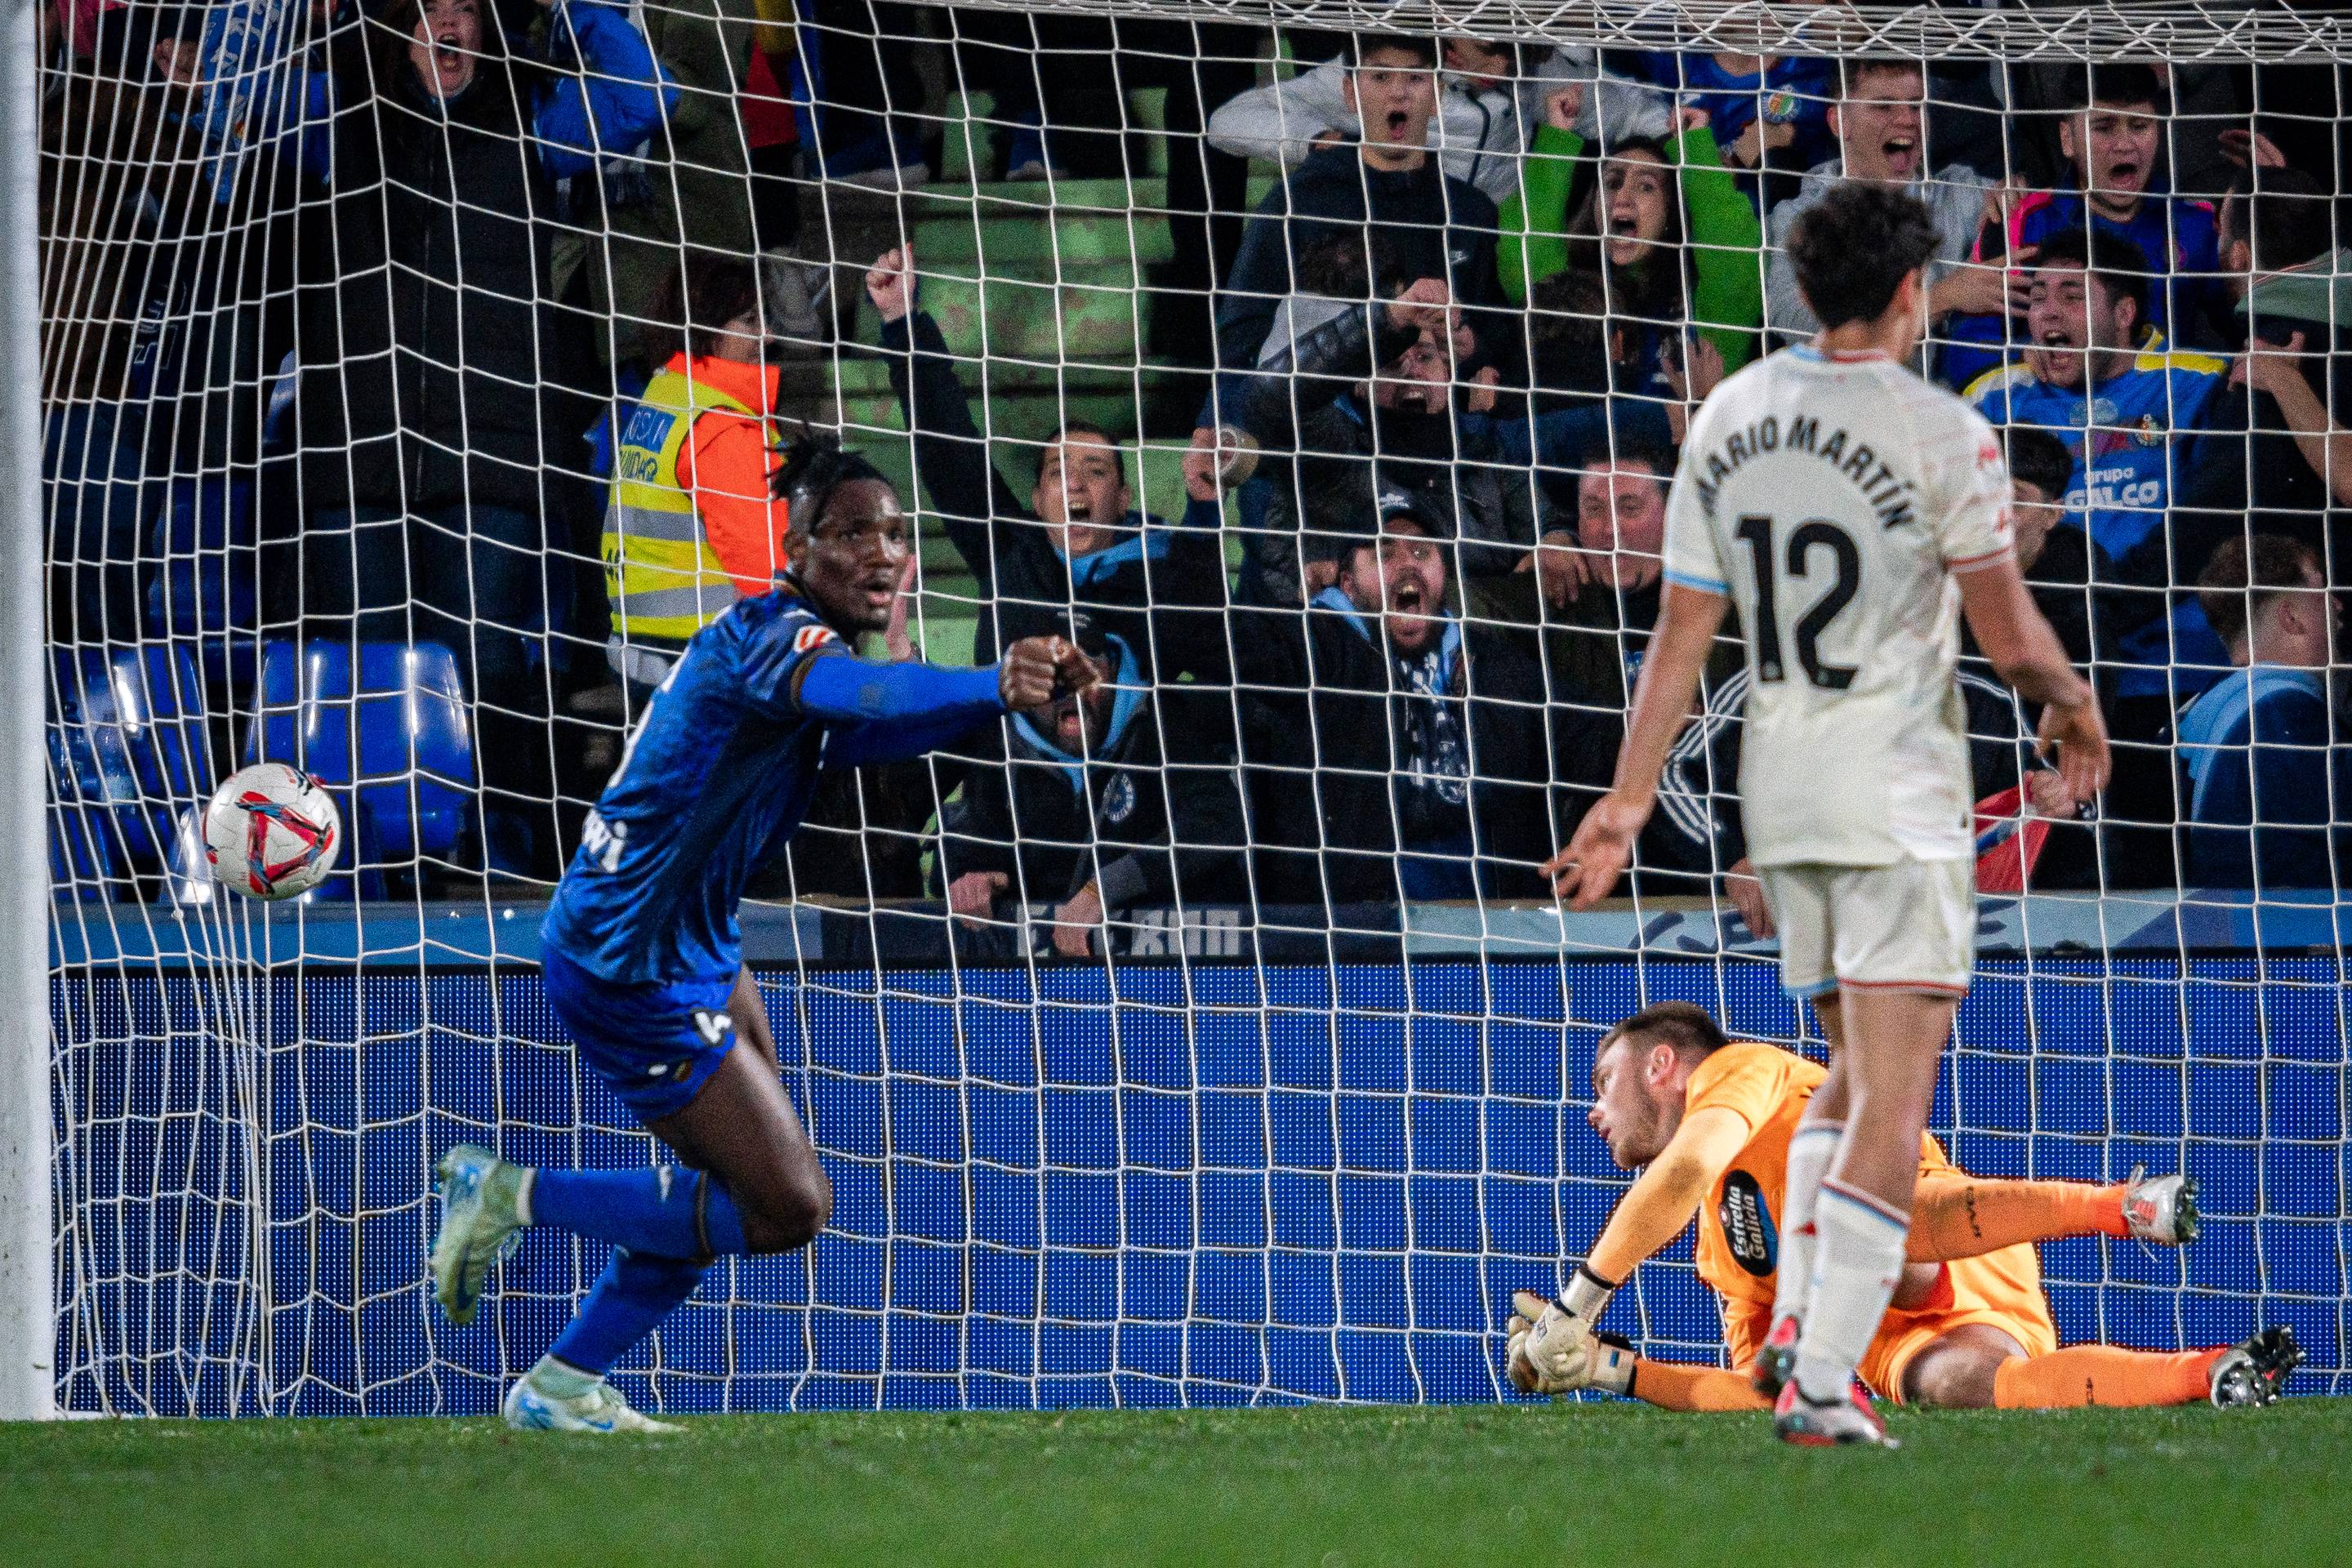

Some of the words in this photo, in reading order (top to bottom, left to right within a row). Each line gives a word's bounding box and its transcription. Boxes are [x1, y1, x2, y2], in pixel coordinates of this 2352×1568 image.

[1695, 416, 1779, 518] MARIO
[1785, 414, 1916, 530] MARTÍN
[2065, 480, 2159, 513] GALCO
[1735, 515, 1860, 689] 12
[1727, 1185, 1747, 1257] Estrella
[1742, 1193, 1766, 1260] Galicia
